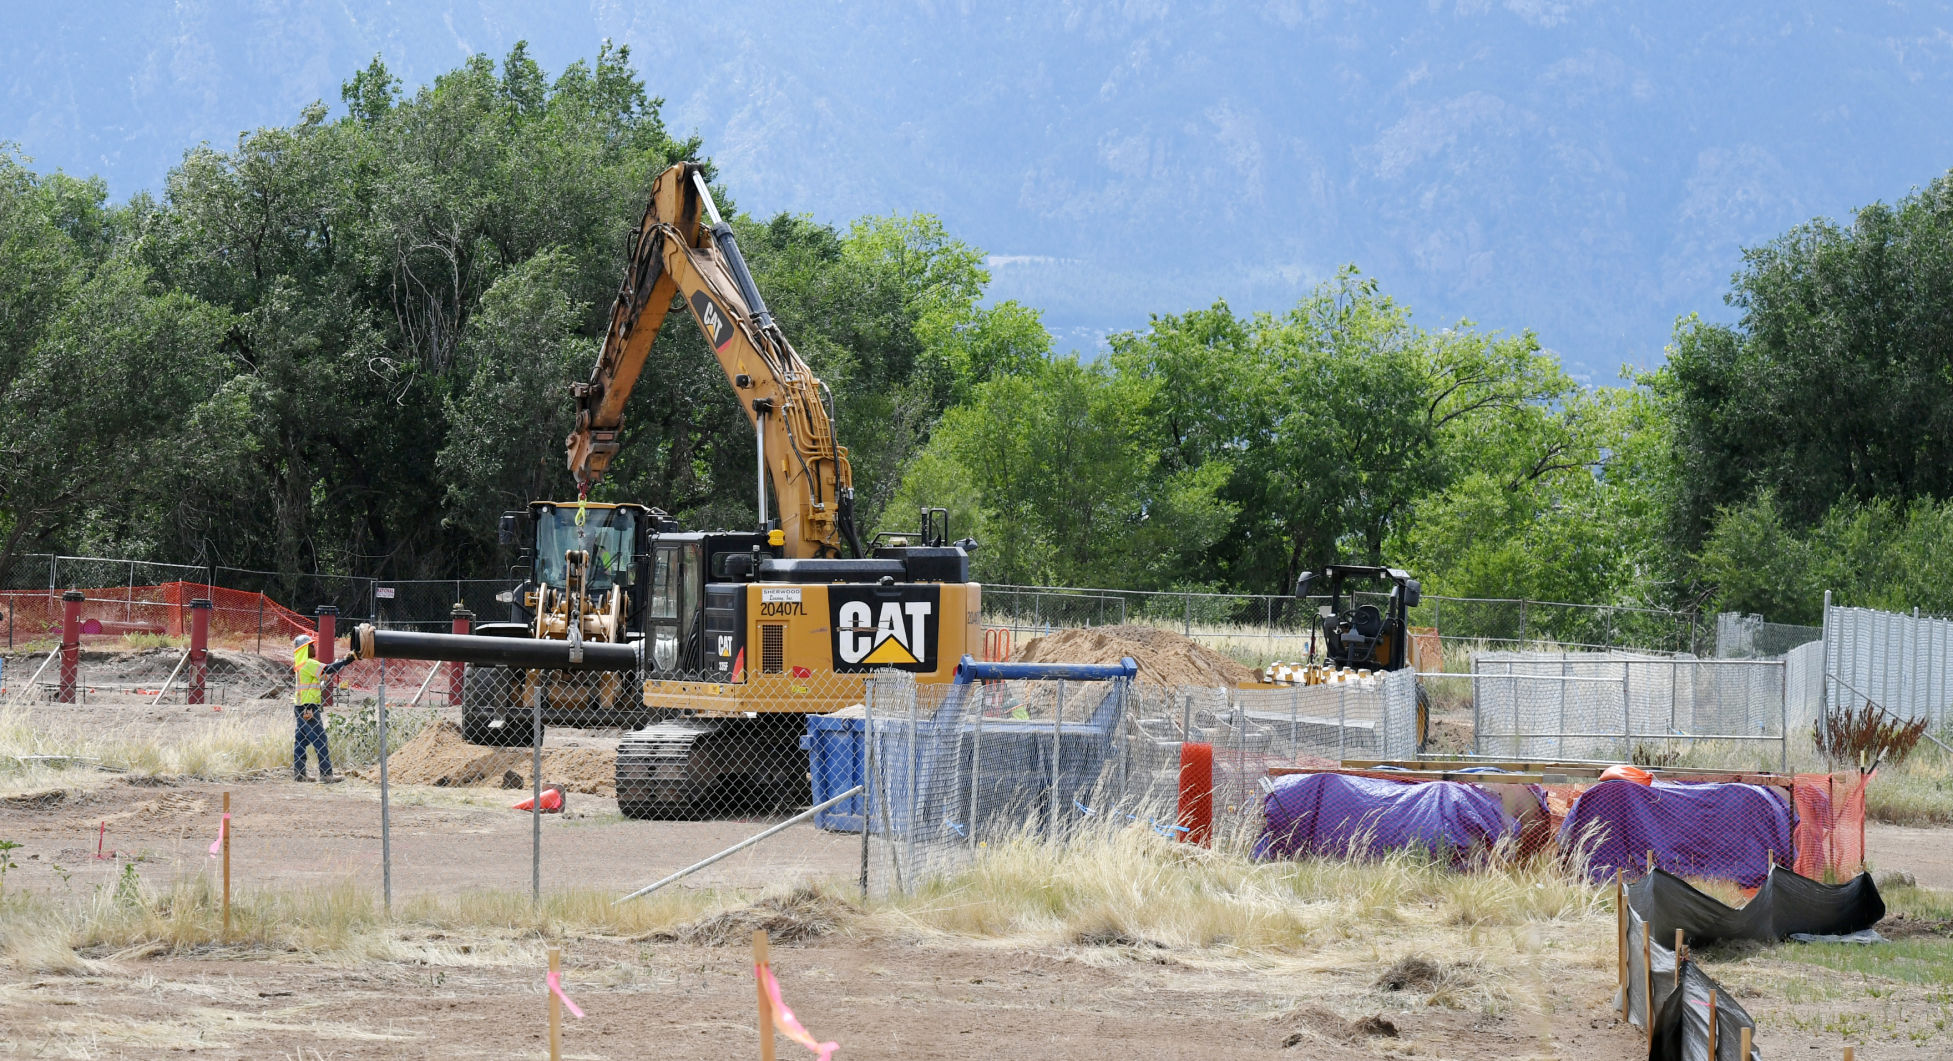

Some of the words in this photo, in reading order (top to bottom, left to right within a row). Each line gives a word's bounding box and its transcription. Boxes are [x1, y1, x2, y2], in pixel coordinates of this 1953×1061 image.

[704, 302, 723, 342] CAT
[760, 602, 807, 616] 20407L
[718, 635, 733, 656] CAT
[839, 601, 931, 663] CAT
